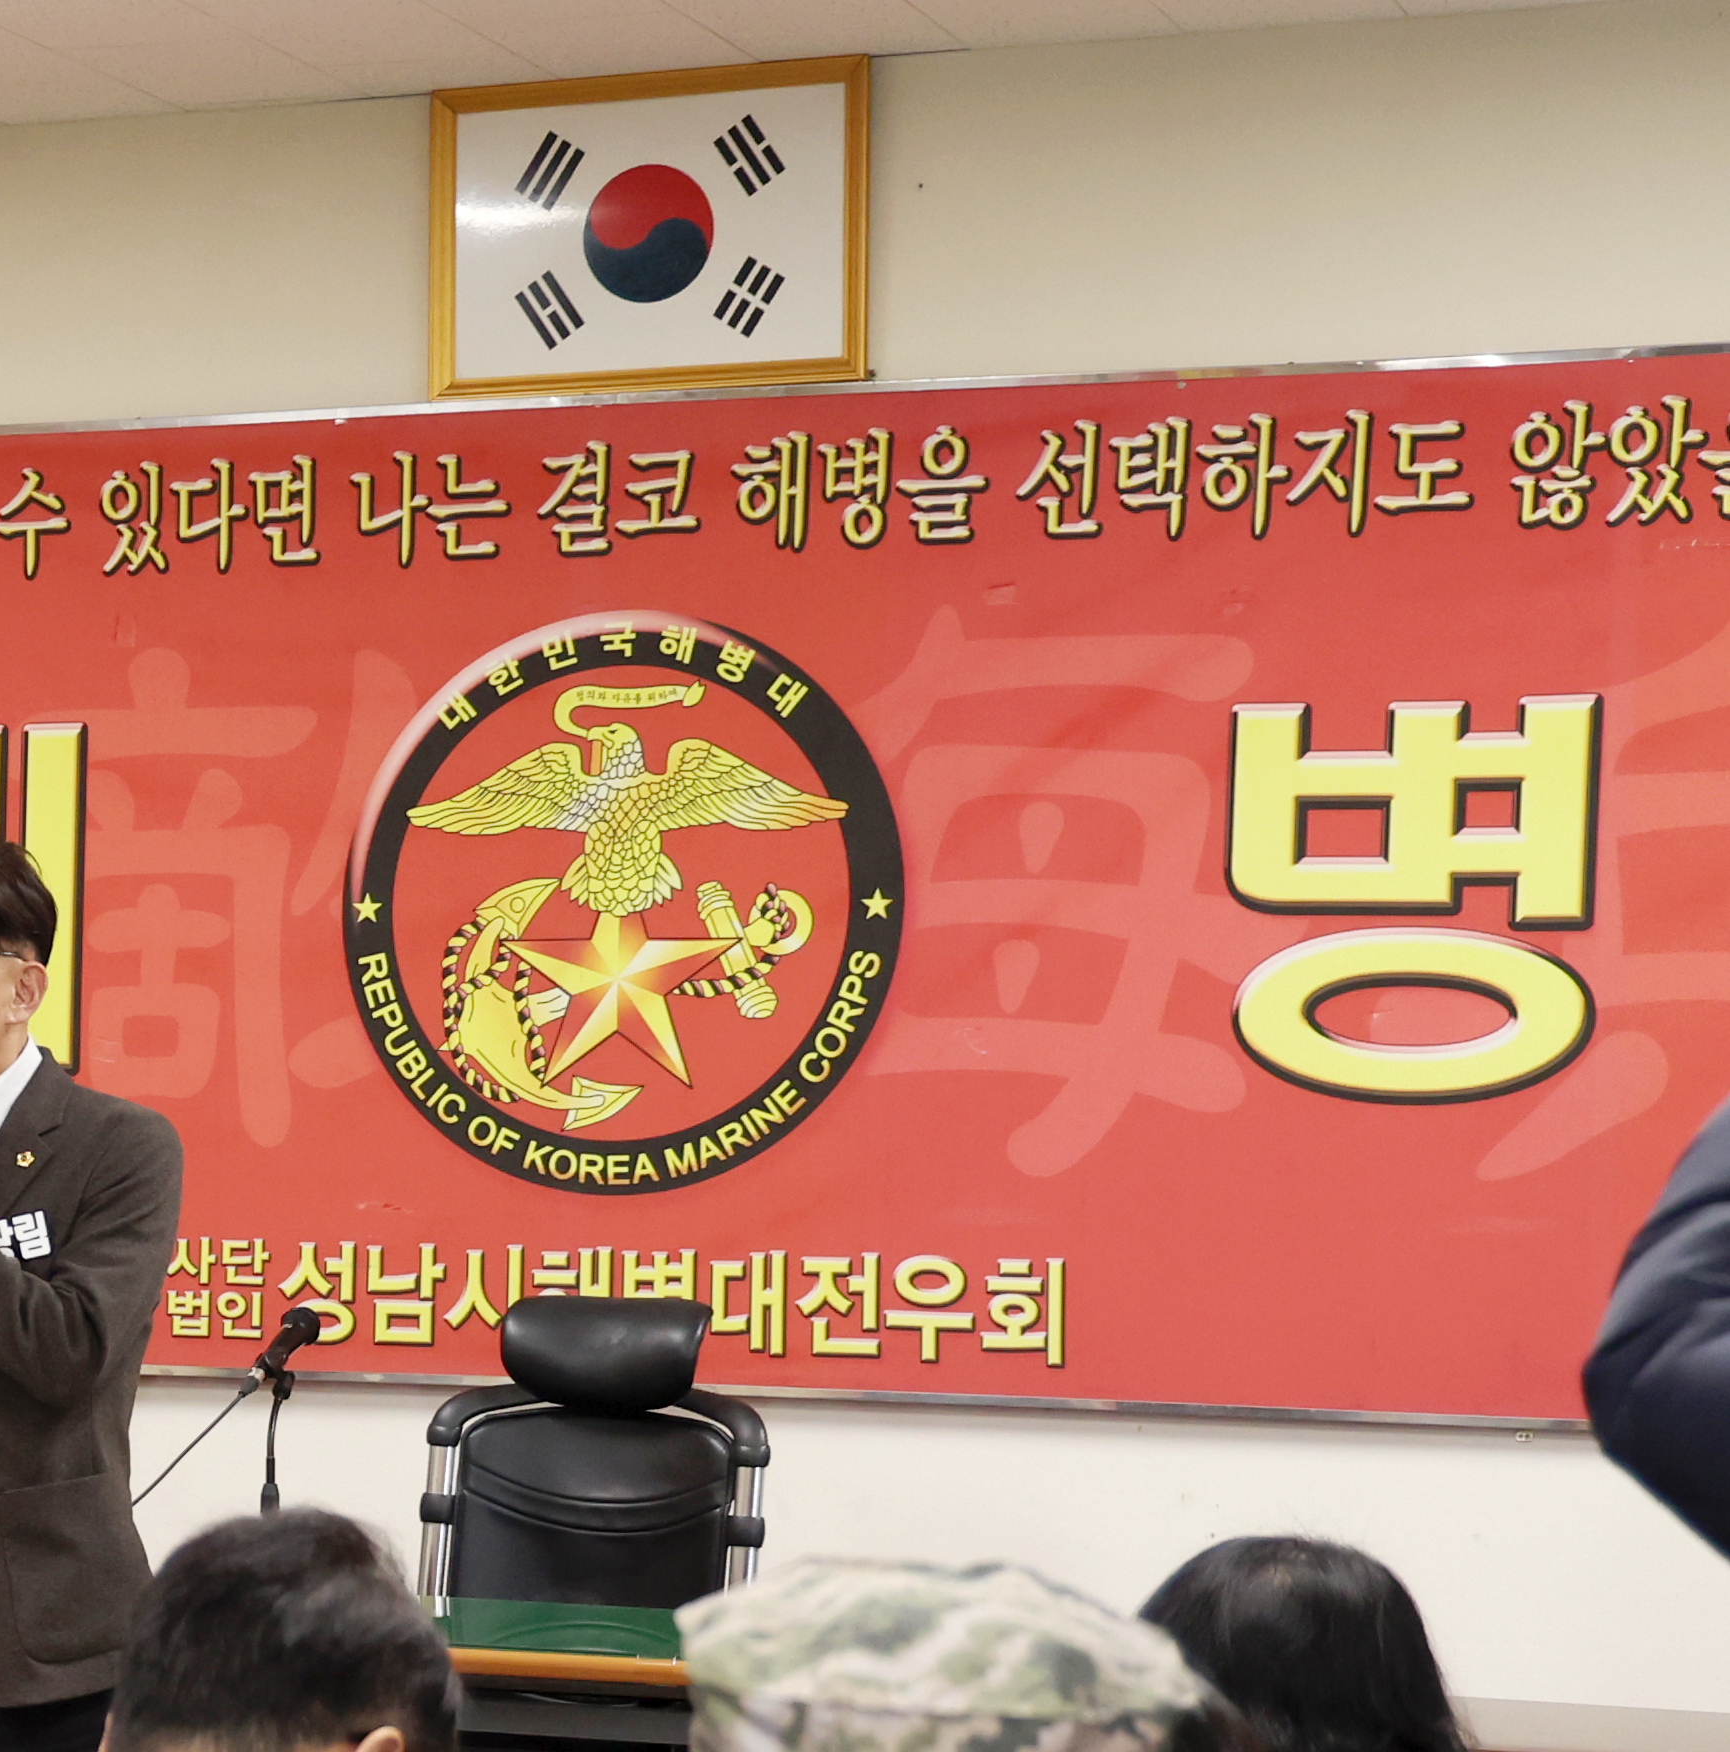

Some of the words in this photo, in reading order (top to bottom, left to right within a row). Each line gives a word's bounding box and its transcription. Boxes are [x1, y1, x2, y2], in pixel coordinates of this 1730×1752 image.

[100, 457, 320, 575] 있다면
[350, 450, 509, 568] 나는
[539, 440, 699, 556] 결코
[730, 425, 987, 550] 해병을
[1017, 407, 1473, 540] 선택하지도
[1510, 394, 1730, 530] 않았
[1225, 693, 1603, 1104] 병
[357, 953, 467, 1125] REPUBLIC
[467, 1115, 520, 1154] OF
[522, 1141, 658, 1187] KOREA
[664, 1081, 808, 1179] MARINE
[798, 949, 883, 1084] CORPS
[166, 1236, 271, 1287] 사단
[166, 1289, 264, 1340] 법인
